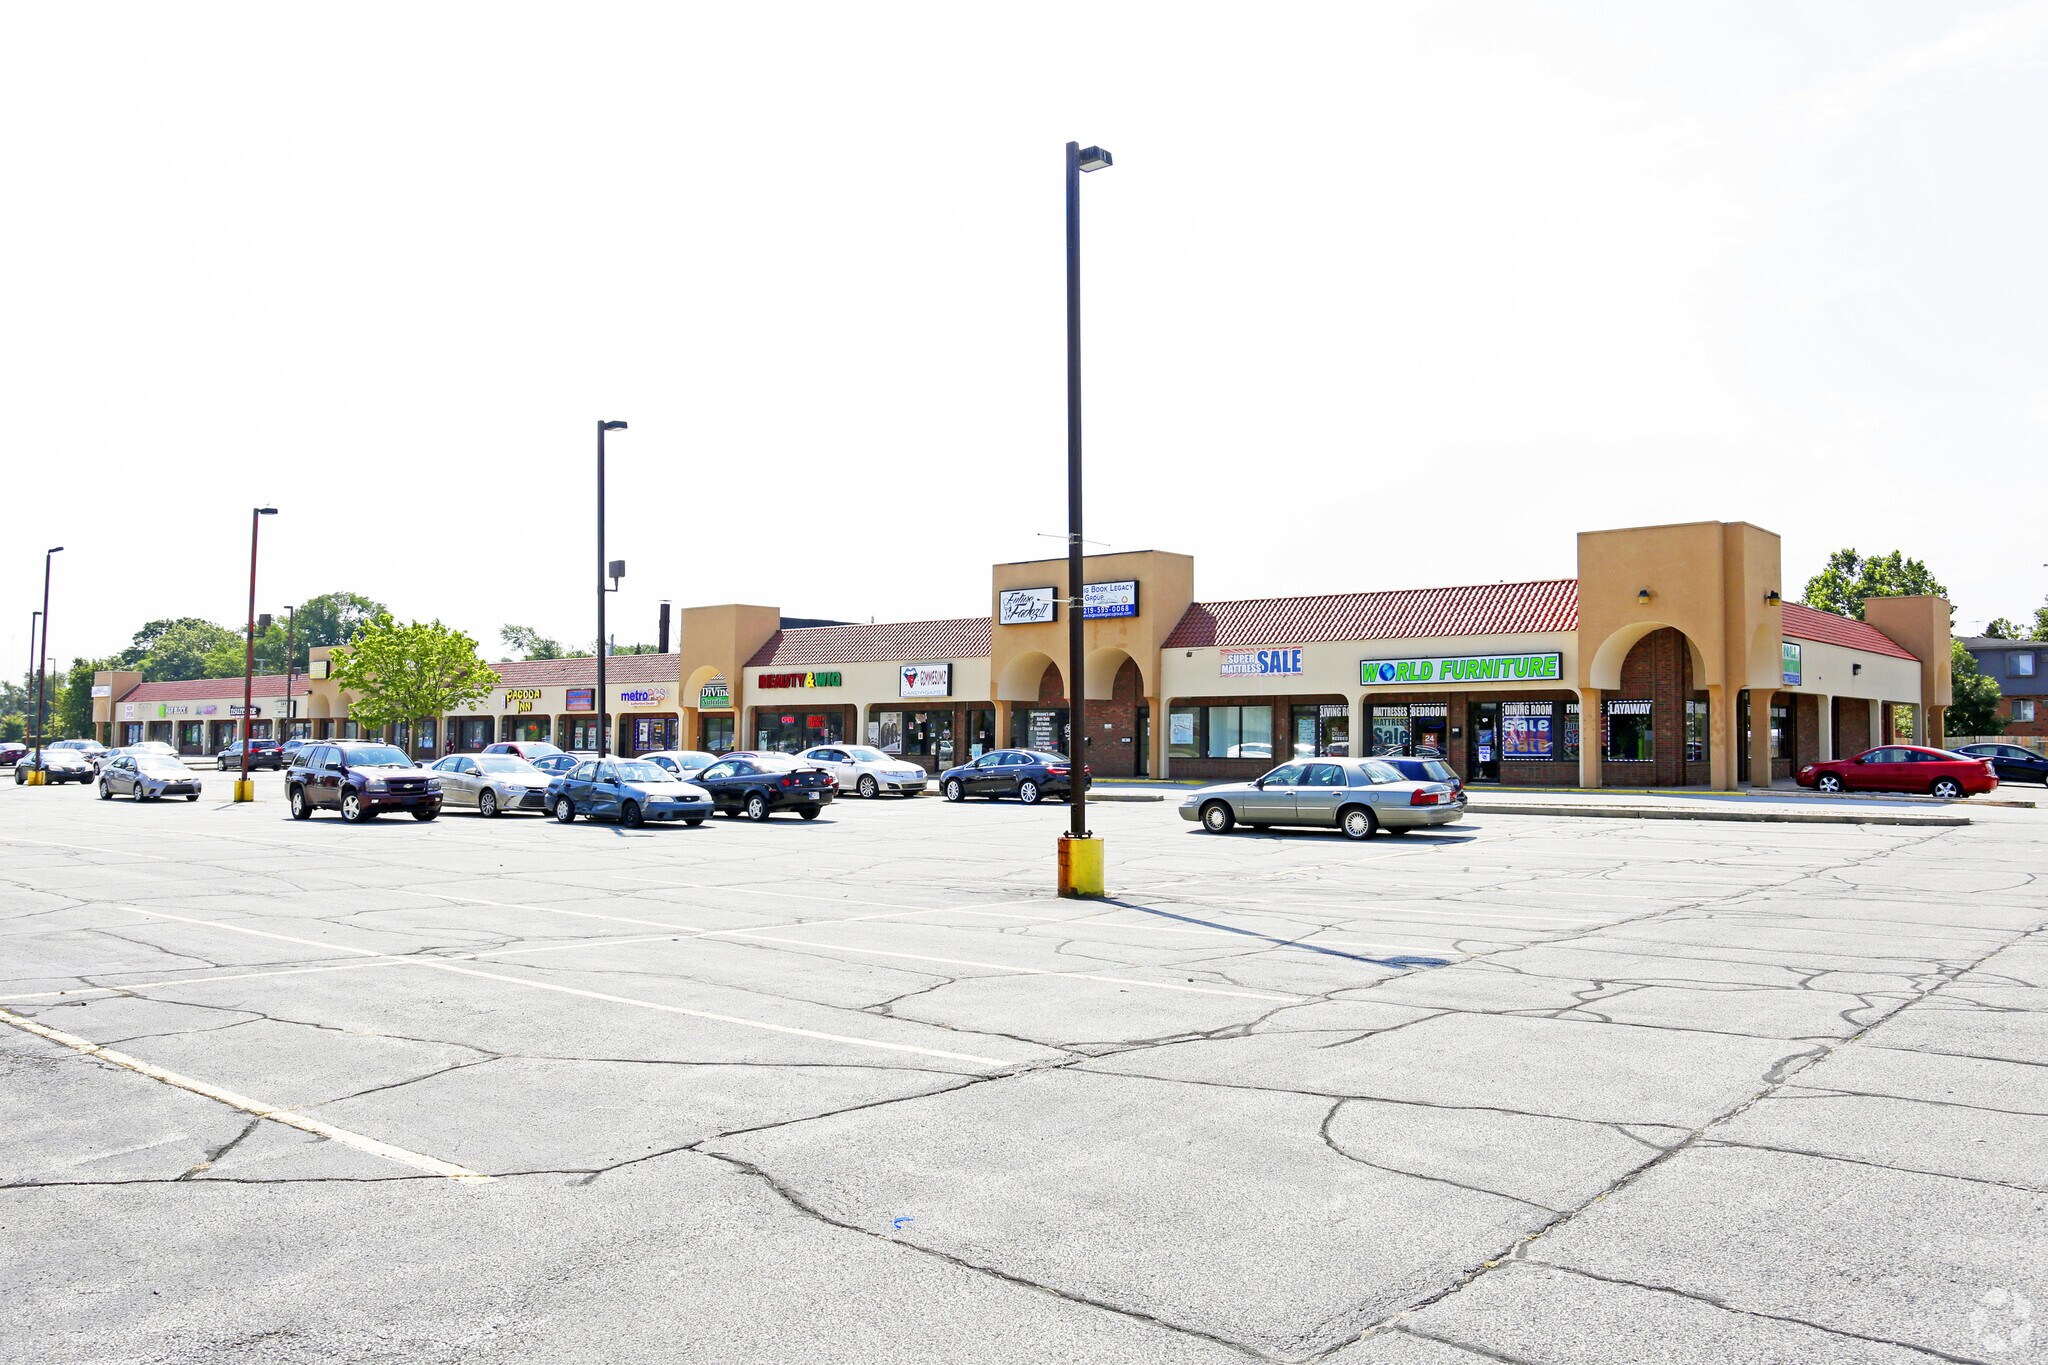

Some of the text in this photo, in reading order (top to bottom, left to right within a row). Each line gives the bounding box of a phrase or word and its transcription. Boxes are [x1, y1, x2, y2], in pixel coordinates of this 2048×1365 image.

[1228, 654, 1255, 664] SUPER
[1257, 649, 1302, 674] SALE
[1221, 663, 1261, 674] MATTRESS
[1363, 655, 1557, 682] WORLD FURNITURE
[758, 673, 806, 689] BEAUTY
[816, 671, 842, 687] WIG
[506, 689, 541, 703] PAGODA
[621, 688, 666, 701] metroPCS
[518, 701, 532, 714] INN
[1321, 707, 1341, 717] LIVING
[1373, 706, 1408, 717] MATTRESSES
[1411, 706, 1448, 717] BEDROOM
[1504, 704, 1553, 715] DINING ROOM
[1609, 703, 1652, 715] LAYAWAY
[1373, 727, 1409, 746] Sale
